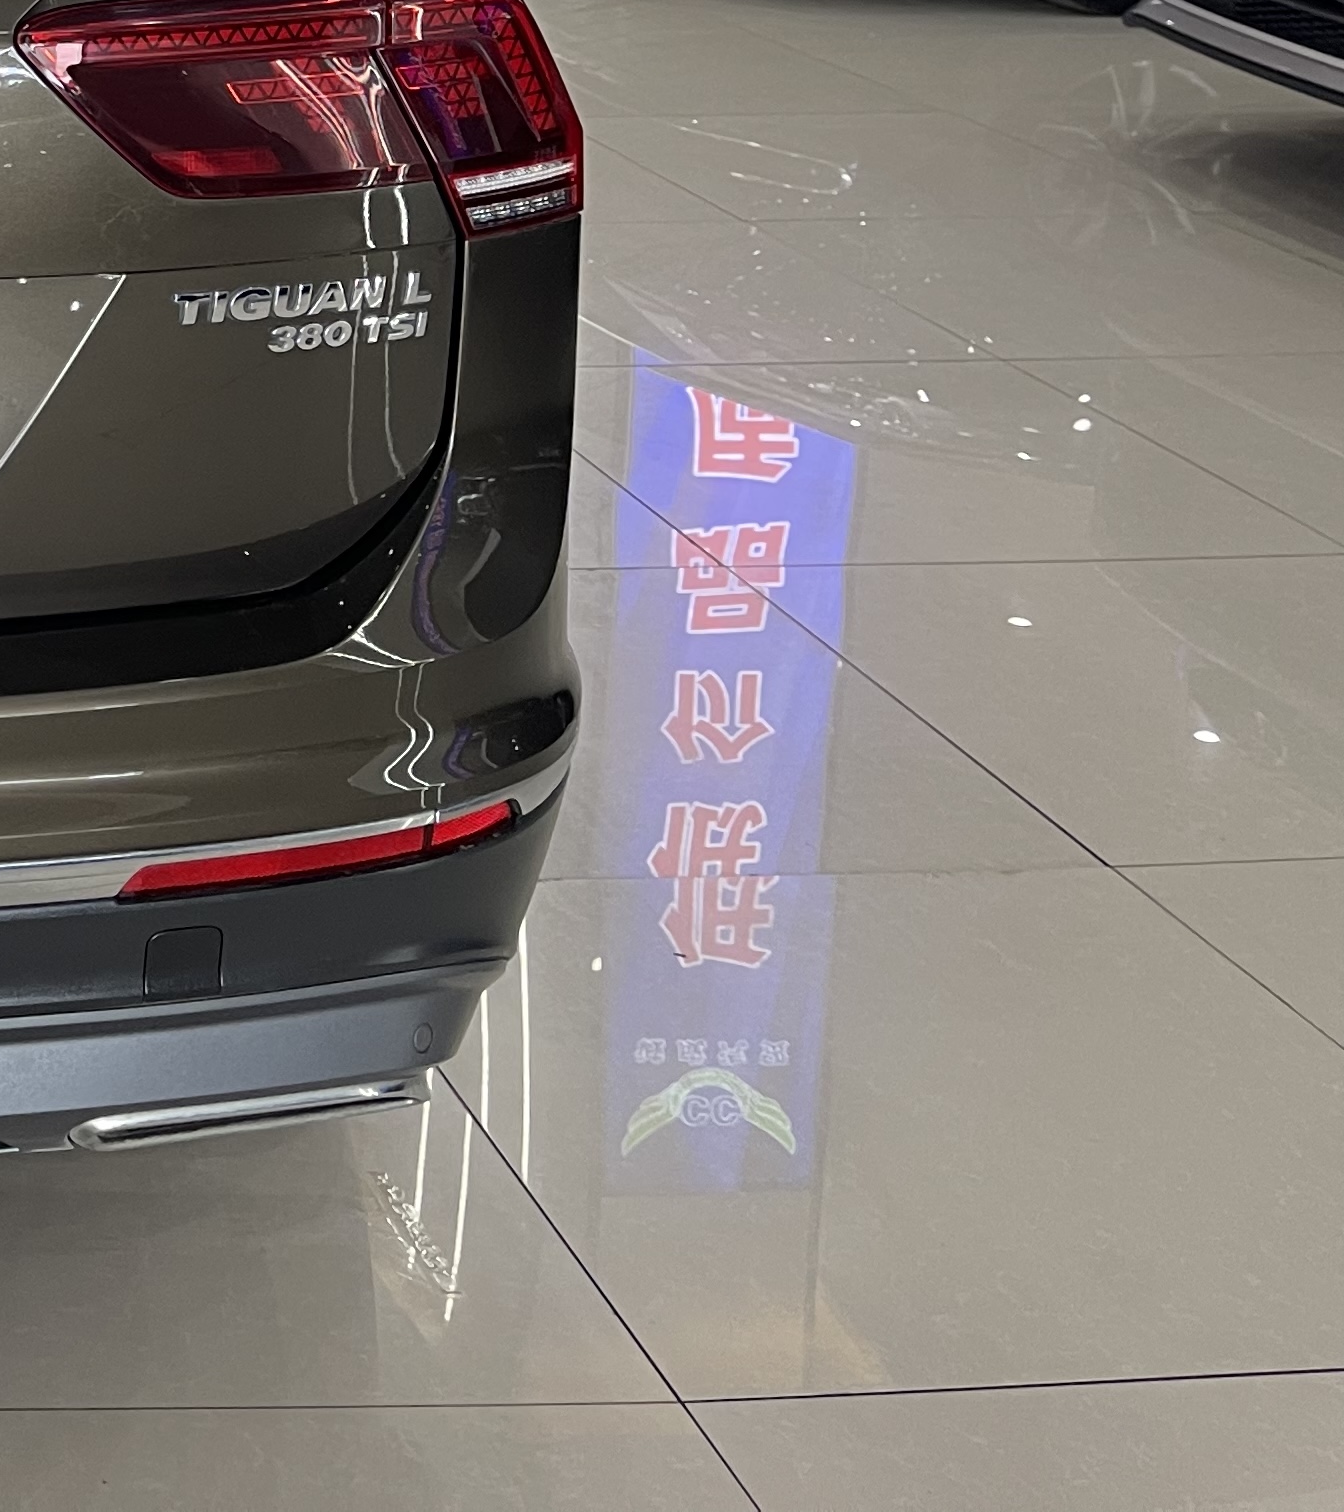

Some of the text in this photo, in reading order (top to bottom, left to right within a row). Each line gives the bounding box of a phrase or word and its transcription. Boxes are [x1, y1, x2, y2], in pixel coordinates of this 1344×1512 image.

[172, 271, 432, 326] TIGUAN L
[267, 311, 429, 354] 380 TSI
